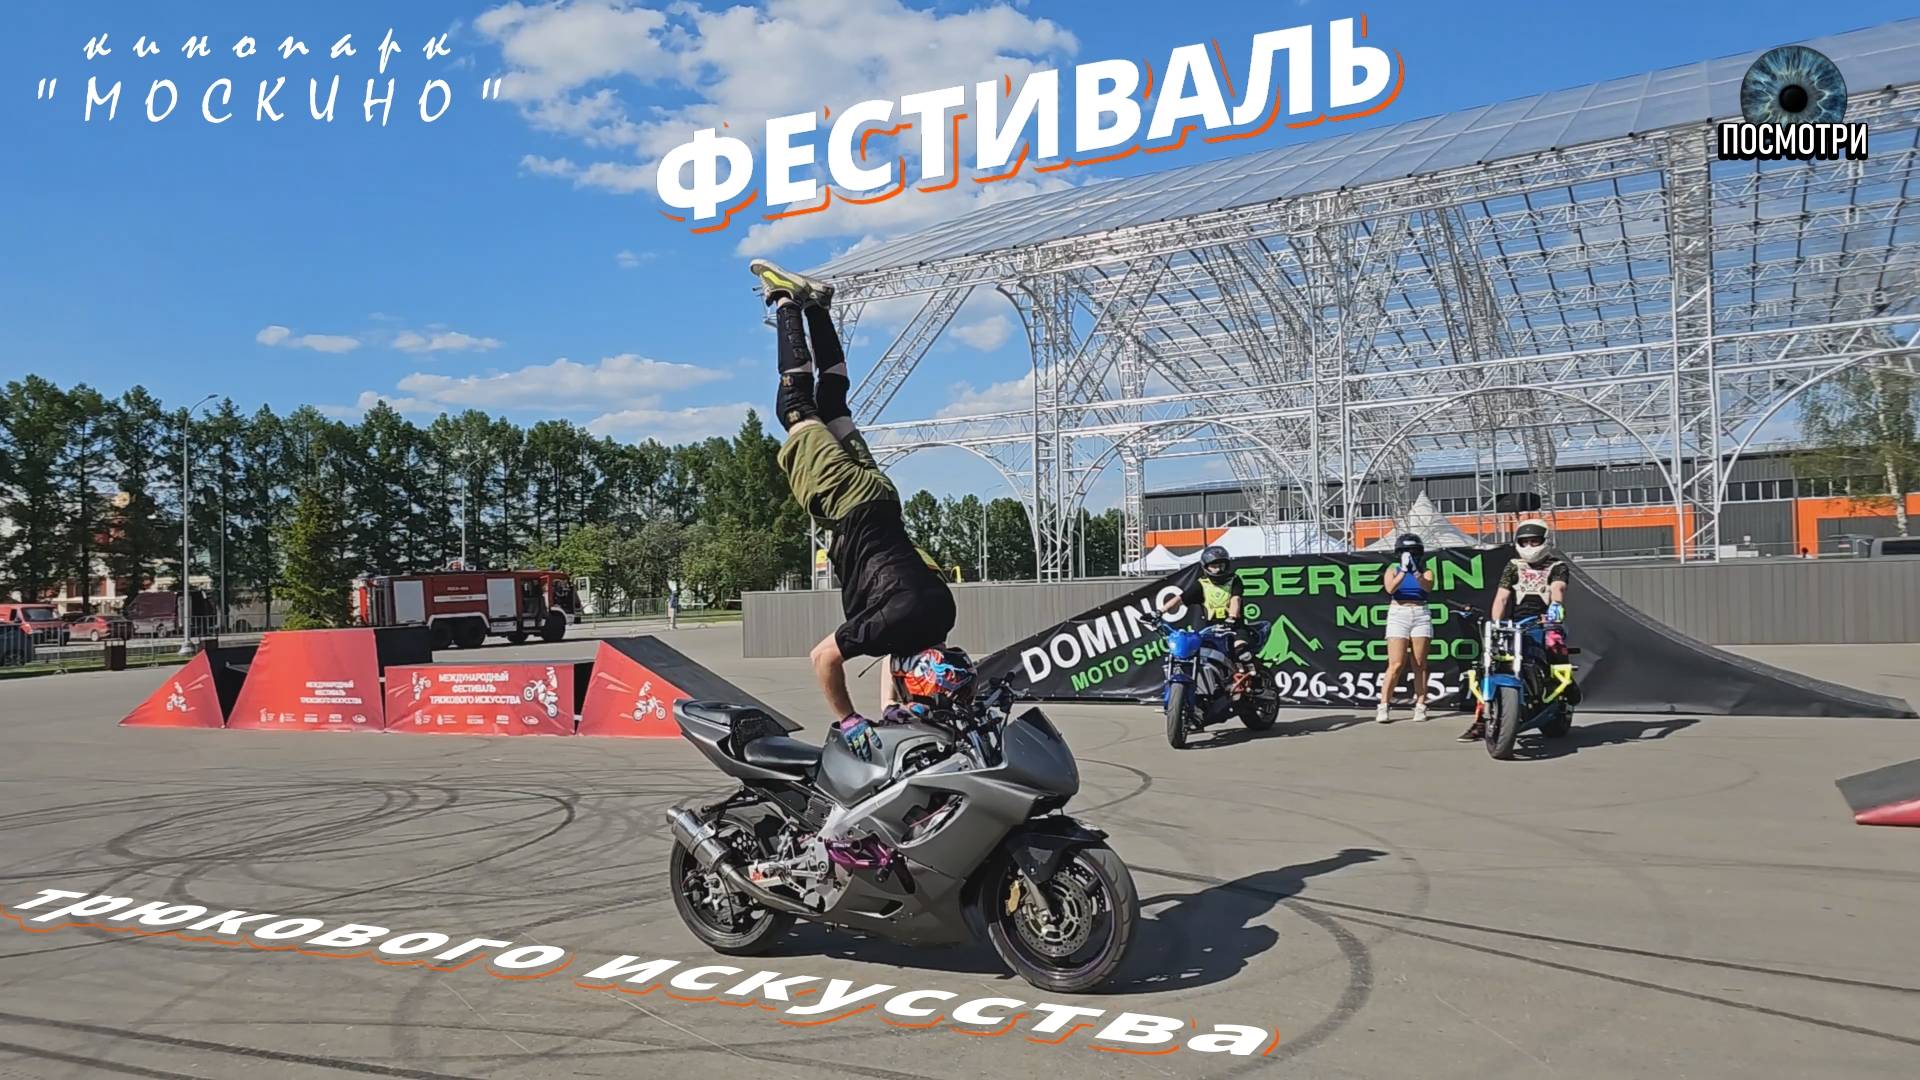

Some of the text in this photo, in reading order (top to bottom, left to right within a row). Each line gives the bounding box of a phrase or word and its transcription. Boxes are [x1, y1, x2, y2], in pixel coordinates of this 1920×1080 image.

[1235, 554, 1484, 598] SEREIN
[1336, 604, 1448, 628] MOO
[1071, 628, 1186, 691] MOTO SHO
